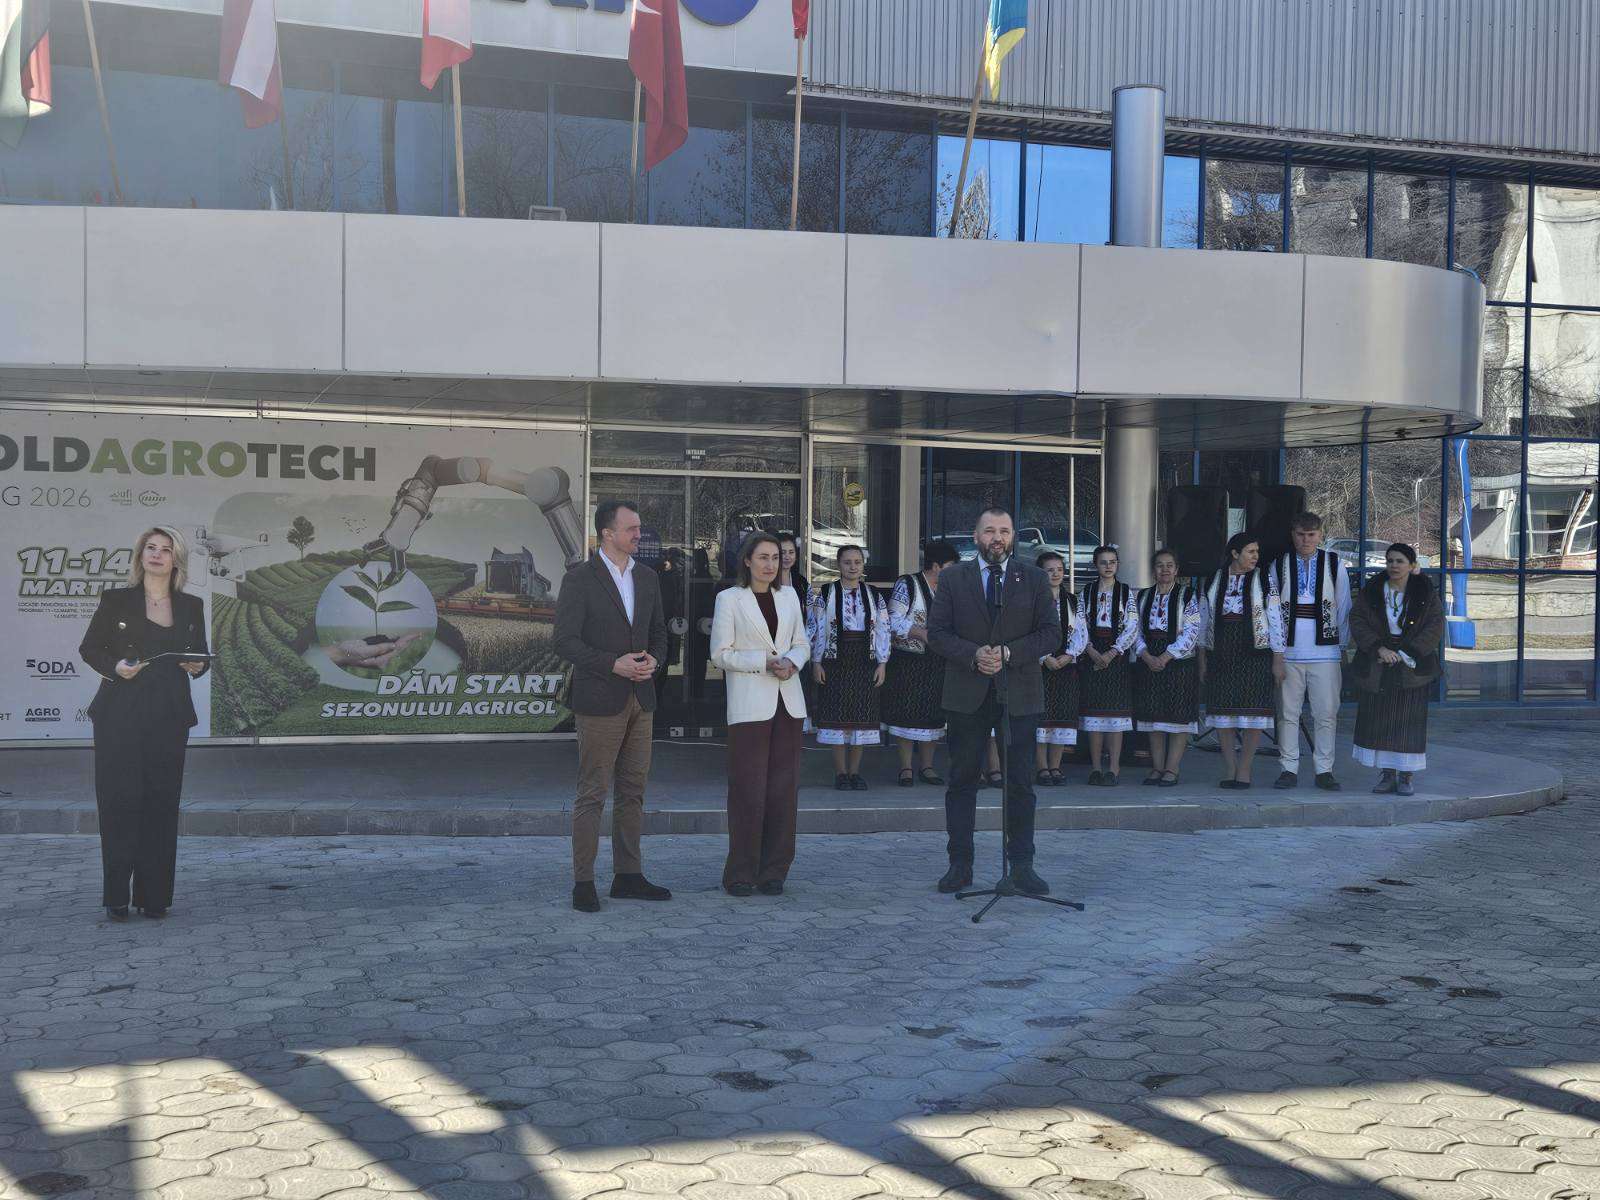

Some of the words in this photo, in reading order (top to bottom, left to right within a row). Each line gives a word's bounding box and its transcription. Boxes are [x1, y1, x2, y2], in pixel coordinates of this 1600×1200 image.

[31, 487, 91, 508] 2026
[18, 547, 133, 575] 11-14
[37, 661, 76, 674] ODA
[377, 669, 458, 695] DĂM
[464, 673, 565, 695] START
[25, 708, 60, 717] AGRO
[320, 701, 453, 718] SEZONULUI
[455, 699, 557, 717] AGRICOL
